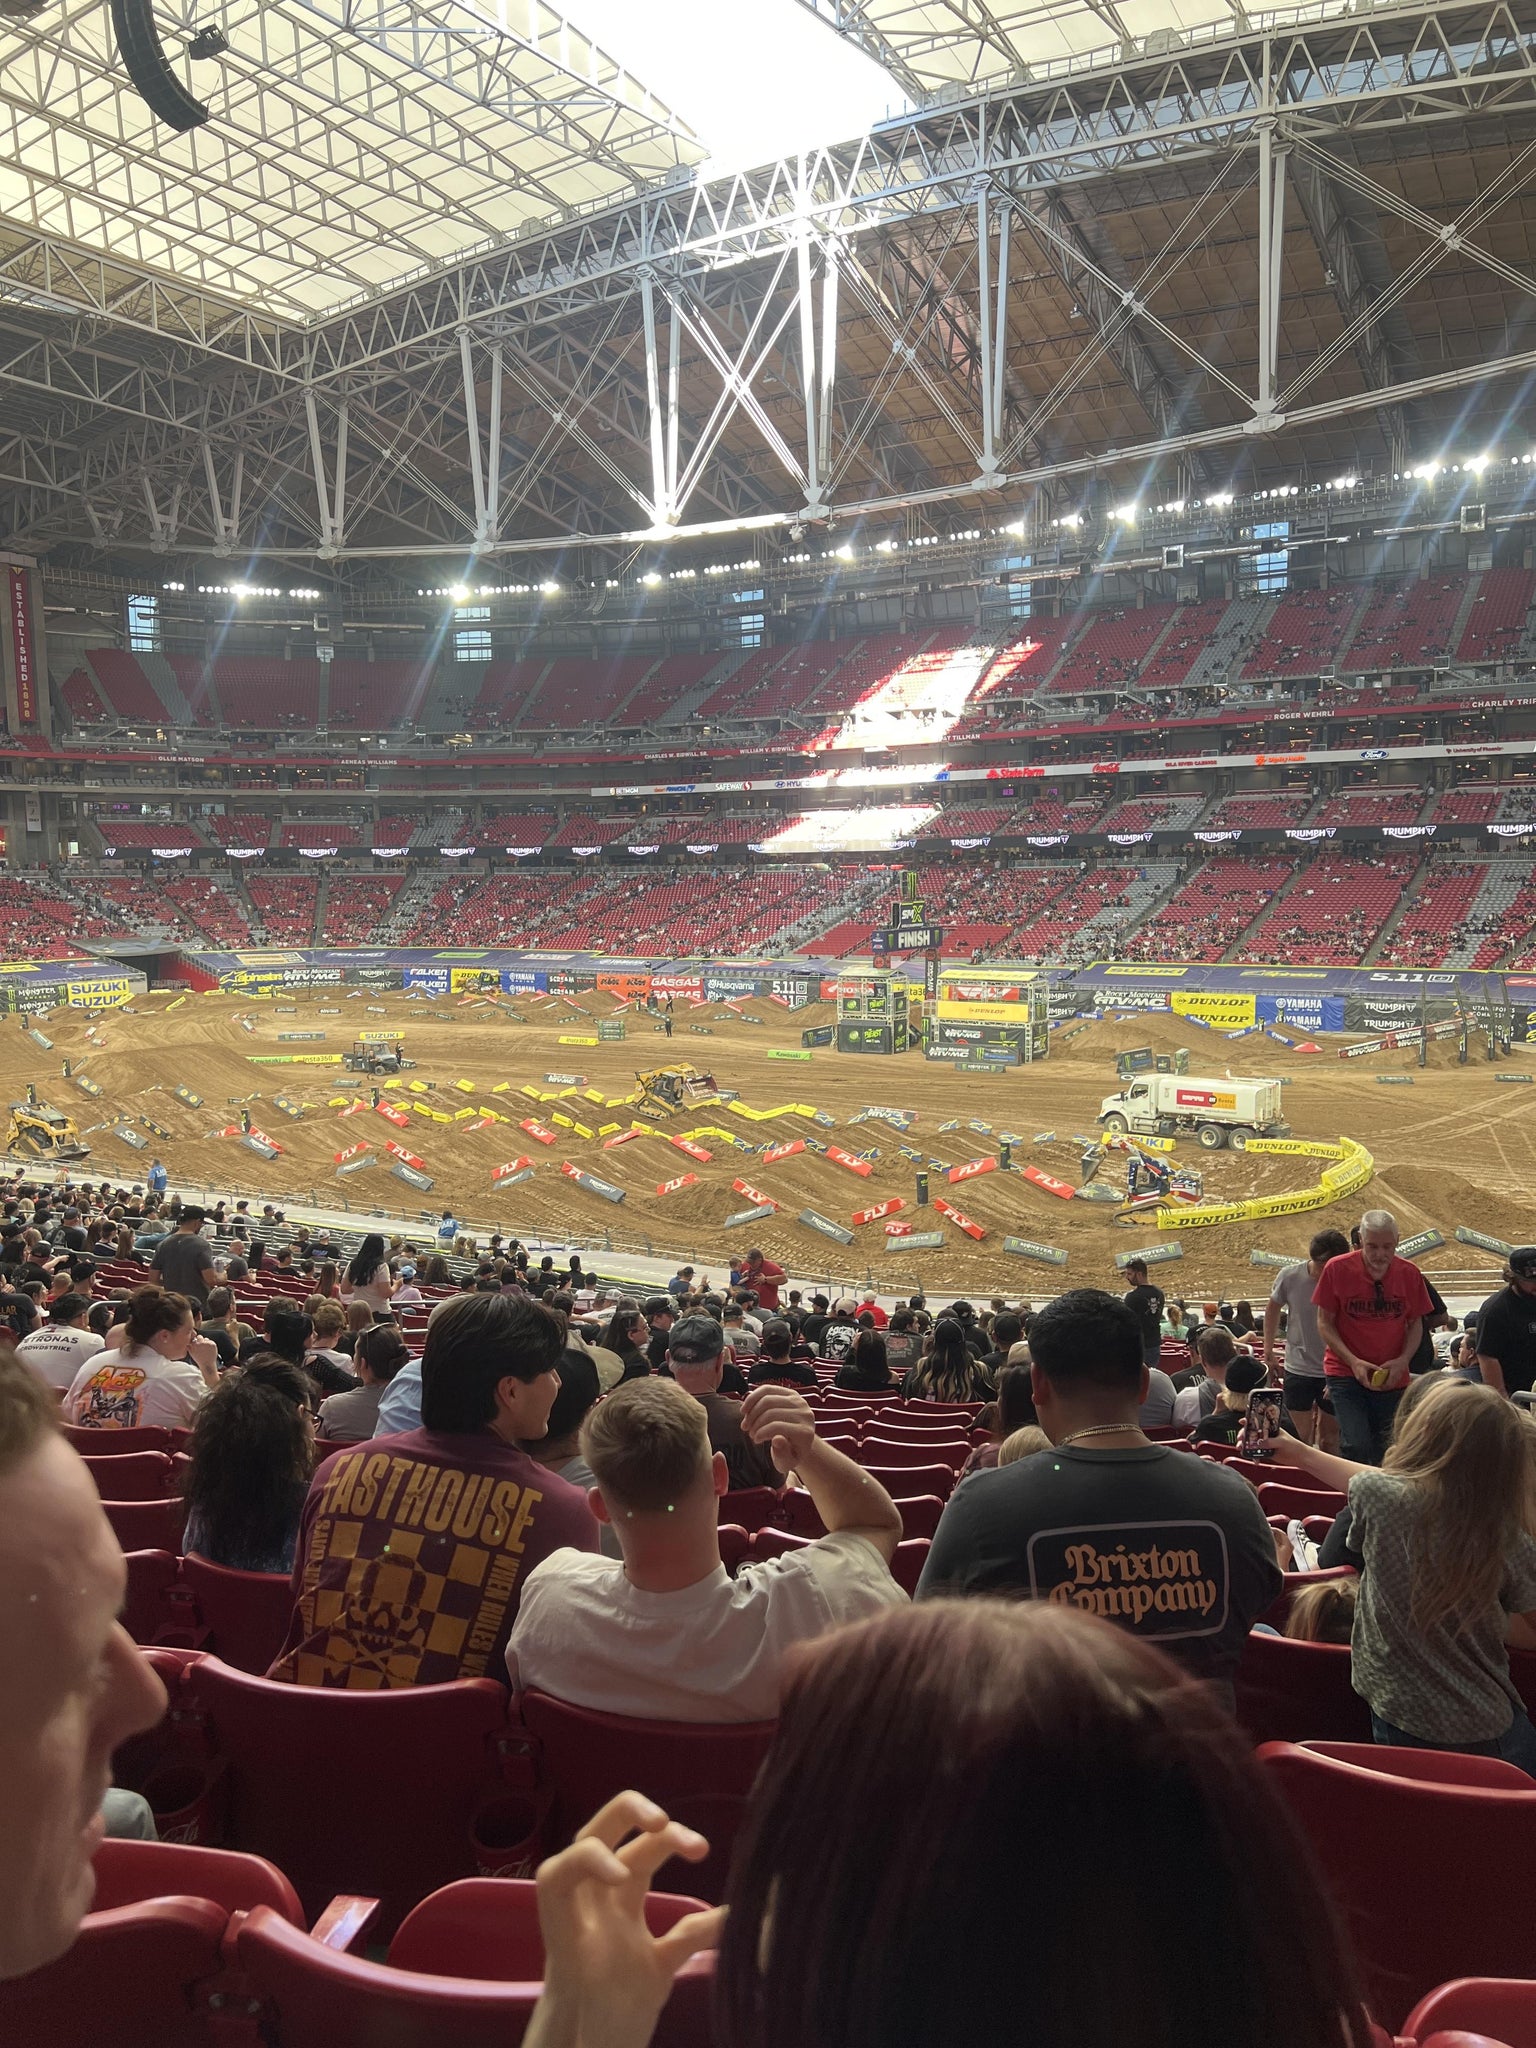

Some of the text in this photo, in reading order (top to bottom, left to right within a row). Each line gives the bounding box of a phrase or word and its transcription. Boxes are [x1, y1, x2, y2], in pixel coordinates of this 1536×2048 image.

[15, 582, 30, 718] ESTABLISHED 1898
[1472, 700, 1514, 708] CHARLEY
[1274, 712, 1301, 720] ROGER
[1303, 710, 1335, 719] WEHRLI
[1364, 750, 1385, 759] Ford
[1000, 767, 1045, 779] State Farm
[1194, 831, 1232, 842] TRIUMPH
[1285, 829, 1326, 840] TRIUMPH
[1382, 827, 1426, 838] TRIUMPH
[1486, 825, 1533, 836] TRIUMPH
[880, 840, 910, 850] TRIUMPH
[951, 838, 982, 848] TRIUMPH
[1026, 836, 1060, 847] TRIUMPH
[1108, 834, 1144, 845] TRIUMPH
[152, 849, 184, 858] TRIUMPH
[226, 848, 258, 858] TRIUMPH
[299, 848, 330, 857] TRIUMPH
[371, 848, 402, 857] TRIUMPH
[686, 845, 713, 854] TRIUMPH
[902, 905, 924, 923] SMX
[898, 930, 930, 949] FINISH
[410, 968, 447, 976] FALKEN
[1370, 972, 1424, 982] 5.11
[71, 981, 126, 994] SUZUKI
[410, 980, 447, 988] FALKEN
[651, 978, 701, 987] GASGAS
[716, 979, 755, 992] Husqvarna
[772, 981, 795, 993] 5.11
[18, 988, 56, 996] MONSTER
[19, 1001, 57, 1010] MONSTER
[71, 996, 122, 1008] SUZUK
[1188, 997, 1250, 1006] DUNLOP
[1285, 999, 1323, 1009] YAMAHA
[1364, 1002, 1406, 1013] TRIUMPH
[1285, 1015, 1322, 1025] YAMAHA
[1363, 1019, 1405, 1031] TRIUMPH
[303, 1054, 333, 1063] Insta360
[776, 1050, 801, 1059] Kawasaki
[381, 1106, 401, 1120] FLY
[528, 1123, 548, 1137] FLY
[254, 1132, 271, 1145] FLY
[341, 1145, 357, 1161] FLY
[679, 1140, 699, 1154] FLY
[772, 1142, 792, 1158] FLY
[1255, 1143, 1301, 1151] DUNLOP
[1310, 1148, 1341, 1157] DUNLOP
[392, 1147, 413, 1161] FLY
[837, 1152, 863, 1168] FLY
[500, 1159, 518, 1176] FLY
[569, 1166, 584, 1180] FL
[959, 1161, 984, 1177] FLY
[664, 1177, 683, 1193] FLY
[1035, 1173, 1064, 1190] FLY
[741, 1186, 765, 1202] FLY
[1269, 1196, 1326, 1214] DUNLOP
[863, 1203, 888, 1222] FLY
[943, 1208, 973, 1230] FLY
[1177, 1211, 1247, 1227] DUNLOP
[811, 1215, 840, 1236] TRIUMPH
[885, 1225, 904, 1234] FLY
[900, 1234, 930, 1243] MONSTER
[1020, 1241, 1053, 1255] MONSTER
[1131, 1247, 1166, 1259] MONSTER
[318, 1452, 543, 1554] FASTHOUSE
[309, 1519, 331, 1561] DAYS
[1065, 1544, 1202, 1585] Brixton
[485, 1553, 521, 1602] WHEN
[470, 1600, 507, 1648] RULES
